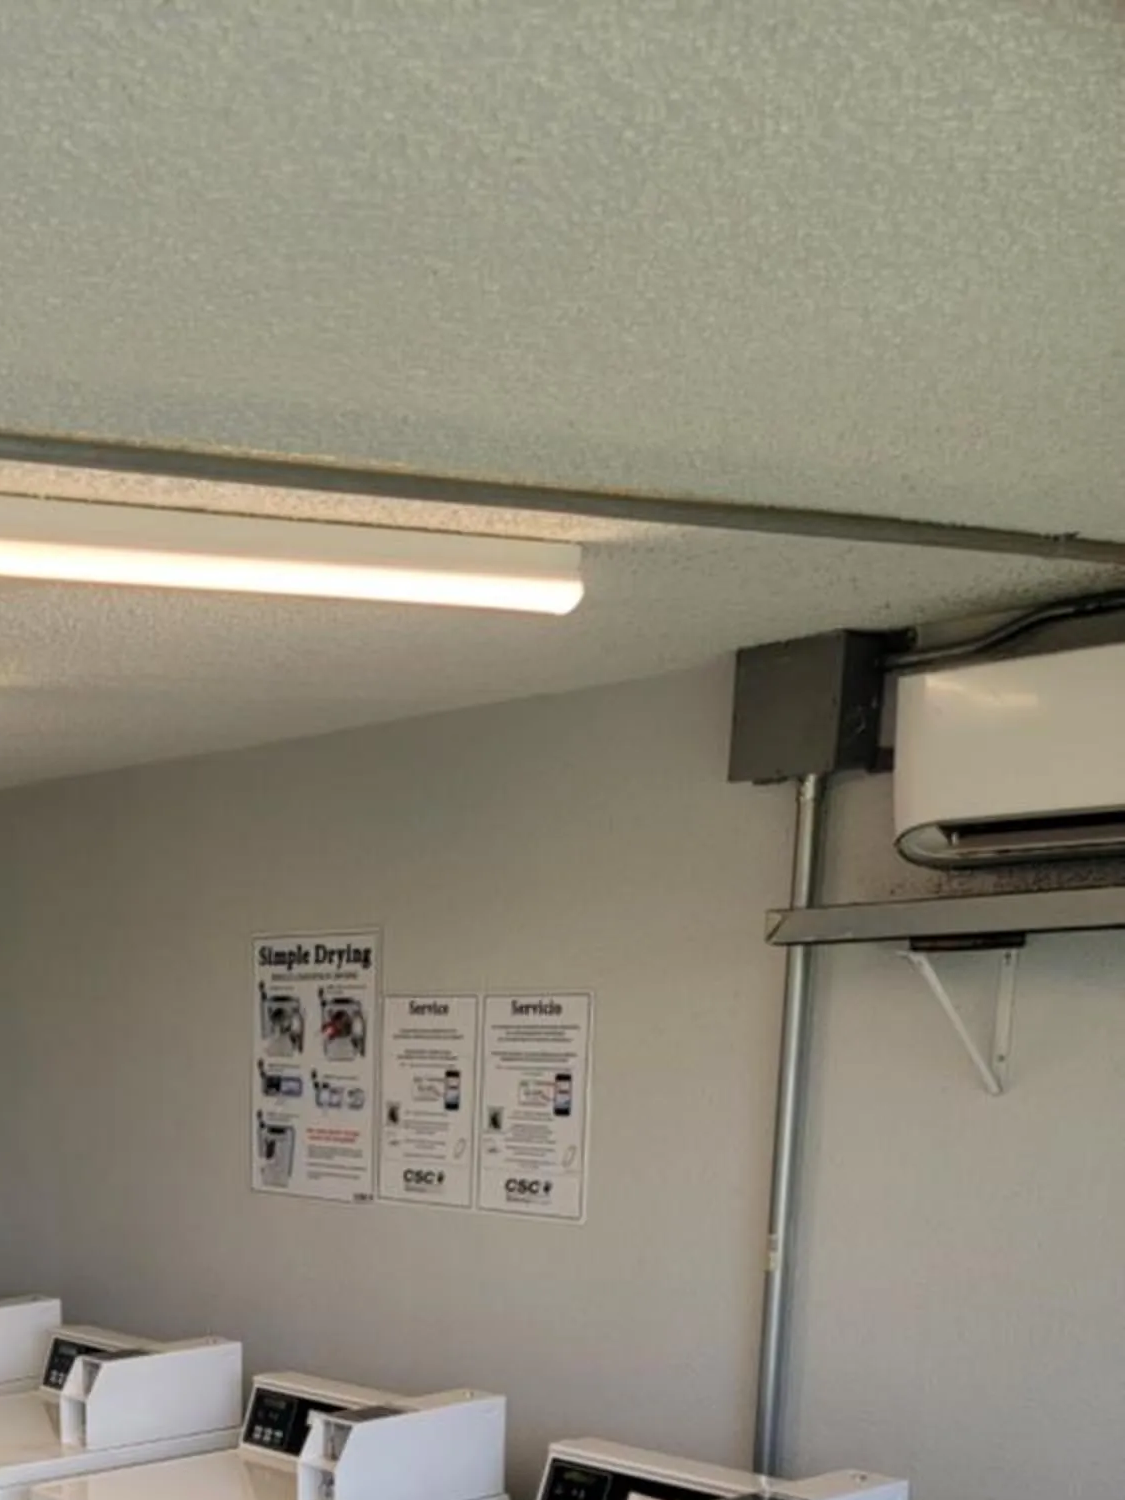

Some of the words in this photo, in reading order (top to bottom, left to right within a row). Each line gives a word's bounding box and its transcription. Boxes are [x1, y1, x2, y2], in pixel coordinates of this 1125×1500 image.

[258, 944, 310, 971] Simple
[314, 943, 372, 970] Drying
[409, 1000, 450, 1015] Service
[511, 1000, 563, 1016] Servicio
[505, 1178, 539, 1195] CSC
